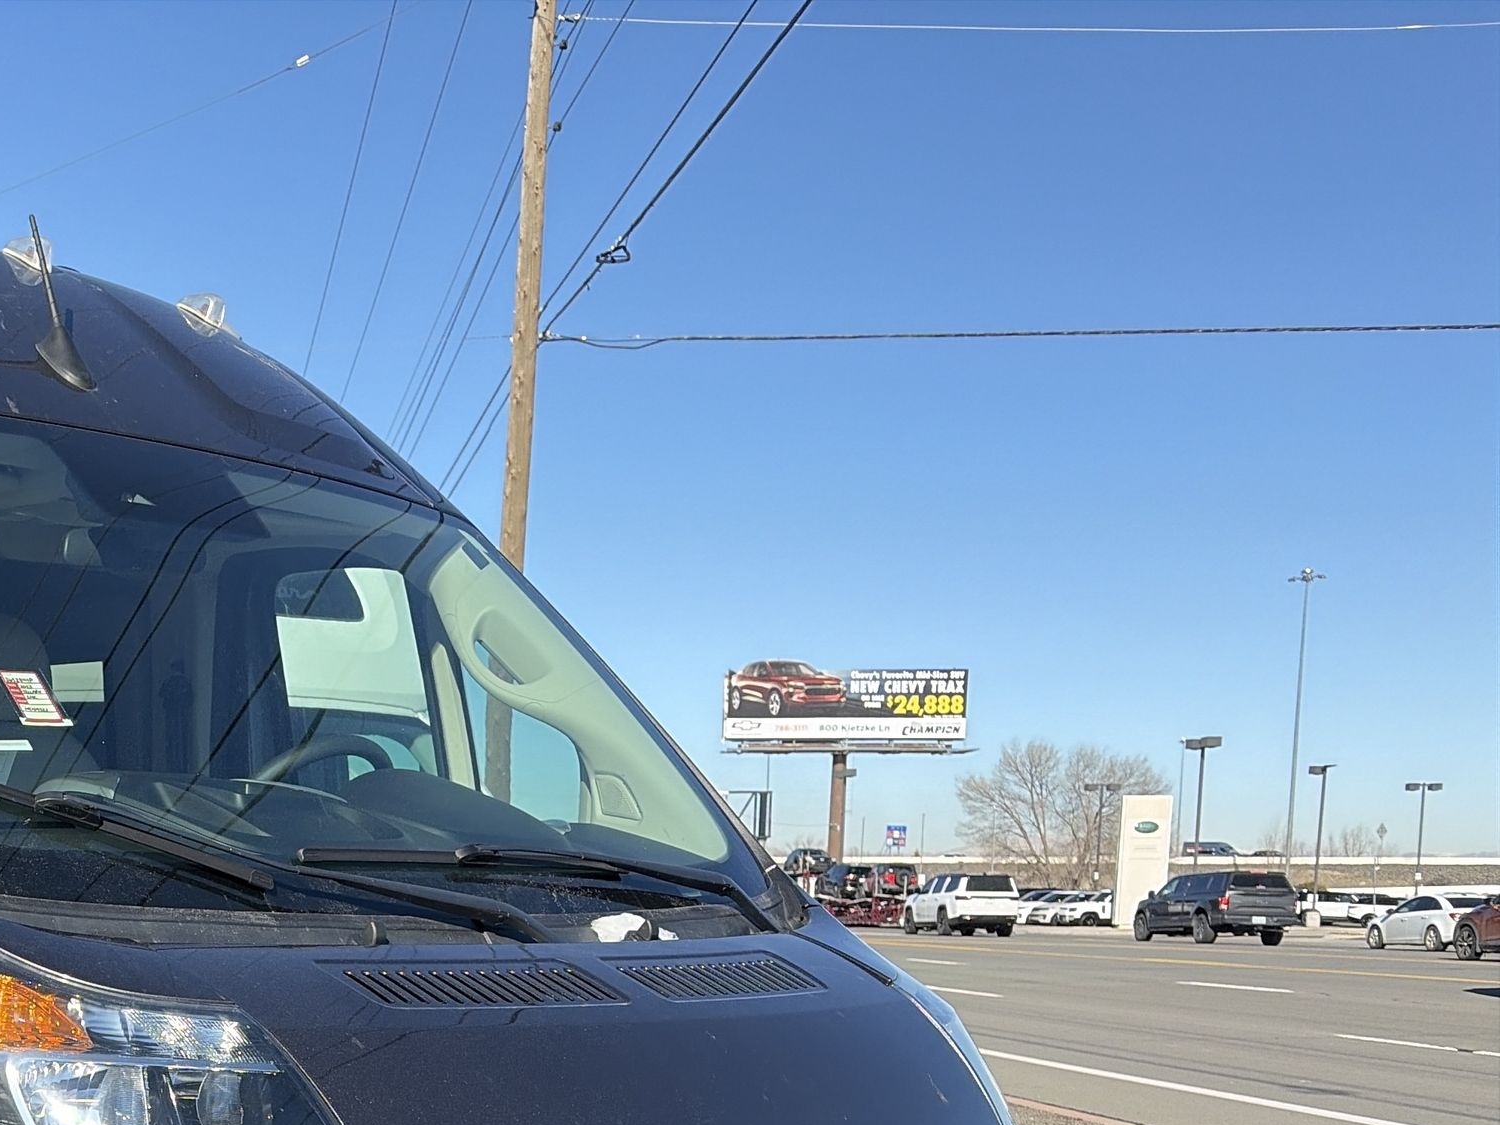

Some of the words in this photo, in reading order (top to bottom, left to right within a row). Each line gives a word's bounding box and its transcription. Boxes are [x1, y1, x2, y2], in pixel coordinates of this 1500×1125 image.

[950, 669, 965, 679] SUV
[850, 680, 882, 694] NEW
[883, 680, 926, 694] CHEVY
[930, 680, 965, 694] TRAX
[886, 694, 965, 716] $24,888
[819, 724, 838, 732] 800
[841, 724, 877, 732] Kietzke
[879, 724, 890, 732] Ln
[902, 725, 961, 736] CHAMPION
